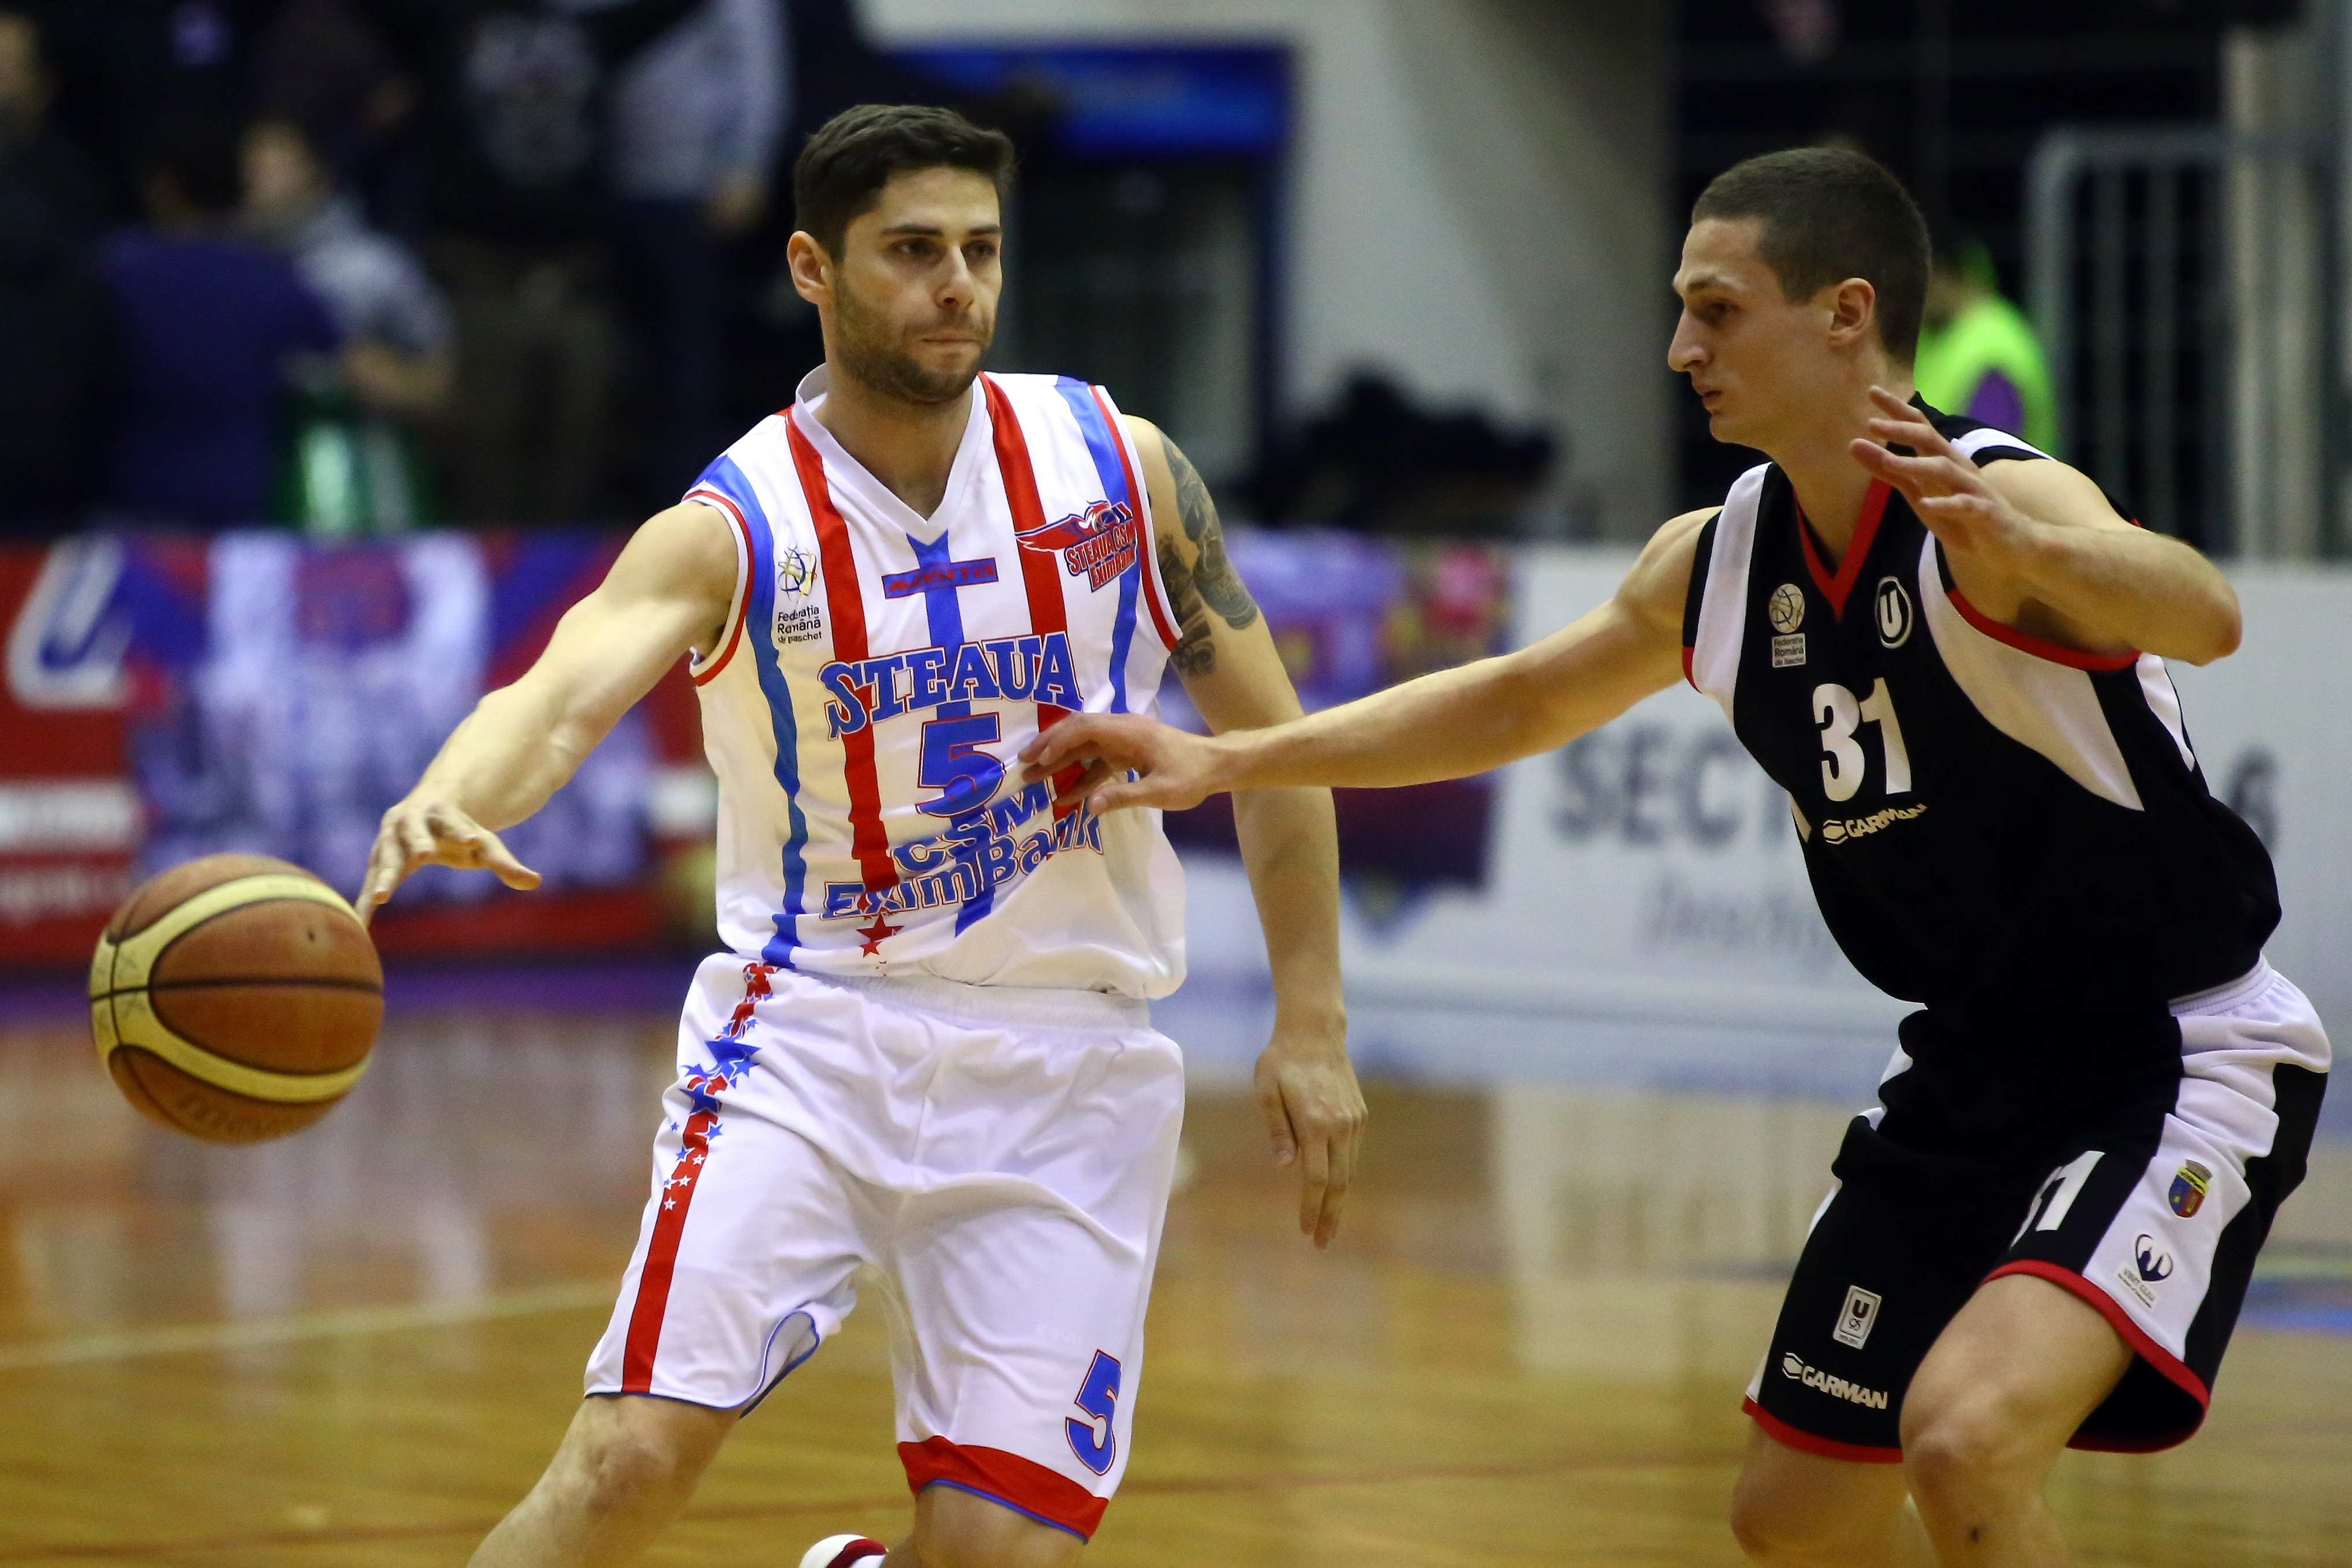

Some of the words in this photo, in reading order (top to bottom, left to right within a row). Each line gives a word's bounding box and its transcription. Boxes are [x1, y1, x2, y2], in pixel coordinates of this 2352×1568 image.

[1066, 531, 1115, 574] STEAUA
[1112, 520, 1136, 550] CSM
[818, 630, 1085, 741] STEAUA
[914, 712, 1006, 818] 5
[1812, 677, 1912, 802] 31
[890, 776, 1058, 873] CSM
[1845, 803, 1928, 838] GARMAN
[1065, 1349, 1122, 1477] 5
[1801, 1365, 1888, 1410] GARMAN
